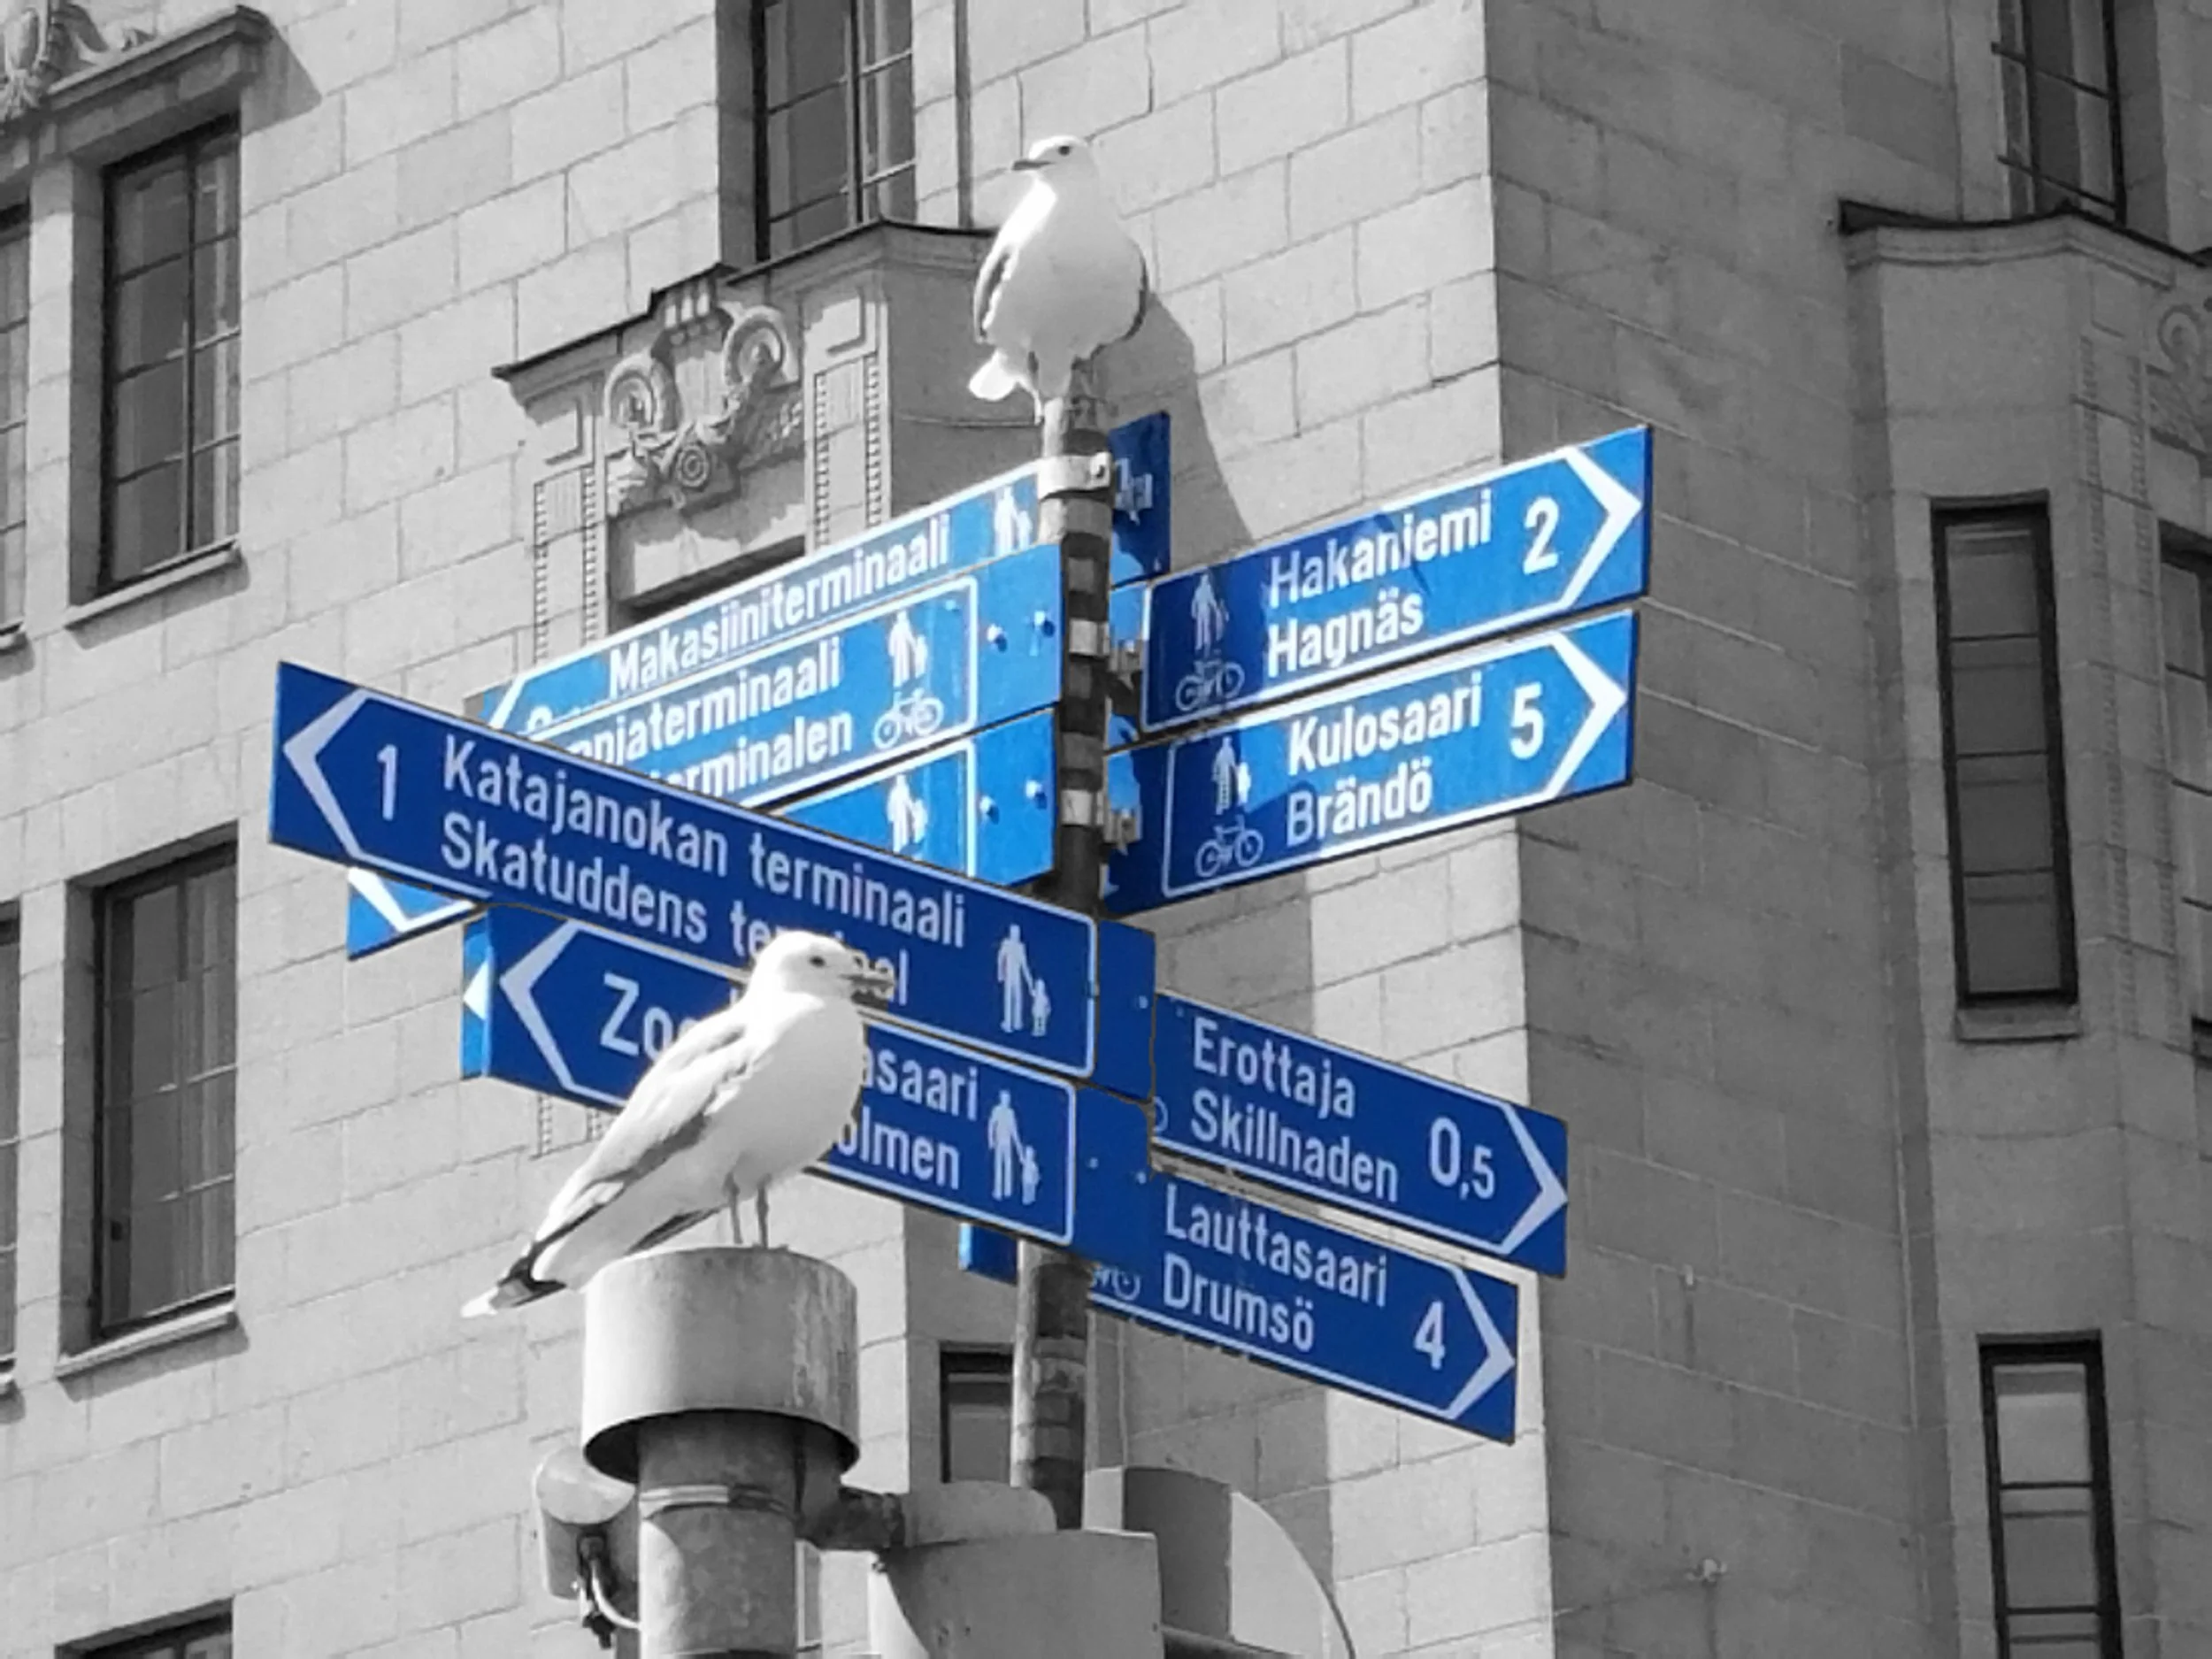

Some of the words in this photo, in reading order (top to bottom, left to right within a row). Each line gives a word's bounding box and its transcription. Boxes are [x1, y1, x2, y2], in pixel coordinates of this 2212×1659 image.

[1270, 489, 1492, 610] Hakaniemi
[1522, 495, 1560, 574] 2
[609, 513, 950, 700] Makasiiniterminaali
[1268, 588, 1424, 679] Hagnäs
[566, 635, 841, 764] iaterminaali
[1288, 672, 1481, 775] Kulosaari
[1509, 683, 1545, 760] 5
[377, 744, 398, 820] 1
[1286, 756, 1432, 847] Brändö
[443, 733, 728, 878] Katajanokan
[749, 832, 965, 949] terminaali
[441, 812, 707, 944] Skatuddens
[729, 899, 909, 1006] teal
[1193, 1016, 1356, 1121] Erottaja
[1190, 1088, 1398, 1203] Skillnaden
[1429, 1116, 1496, 1201] 0,5
[1164, 1185, 1387, 1308] Lauttasaari
[1163, 1253, 1315, 1352] Drumsö
[1414, 1300, 1446, 1370] 4
